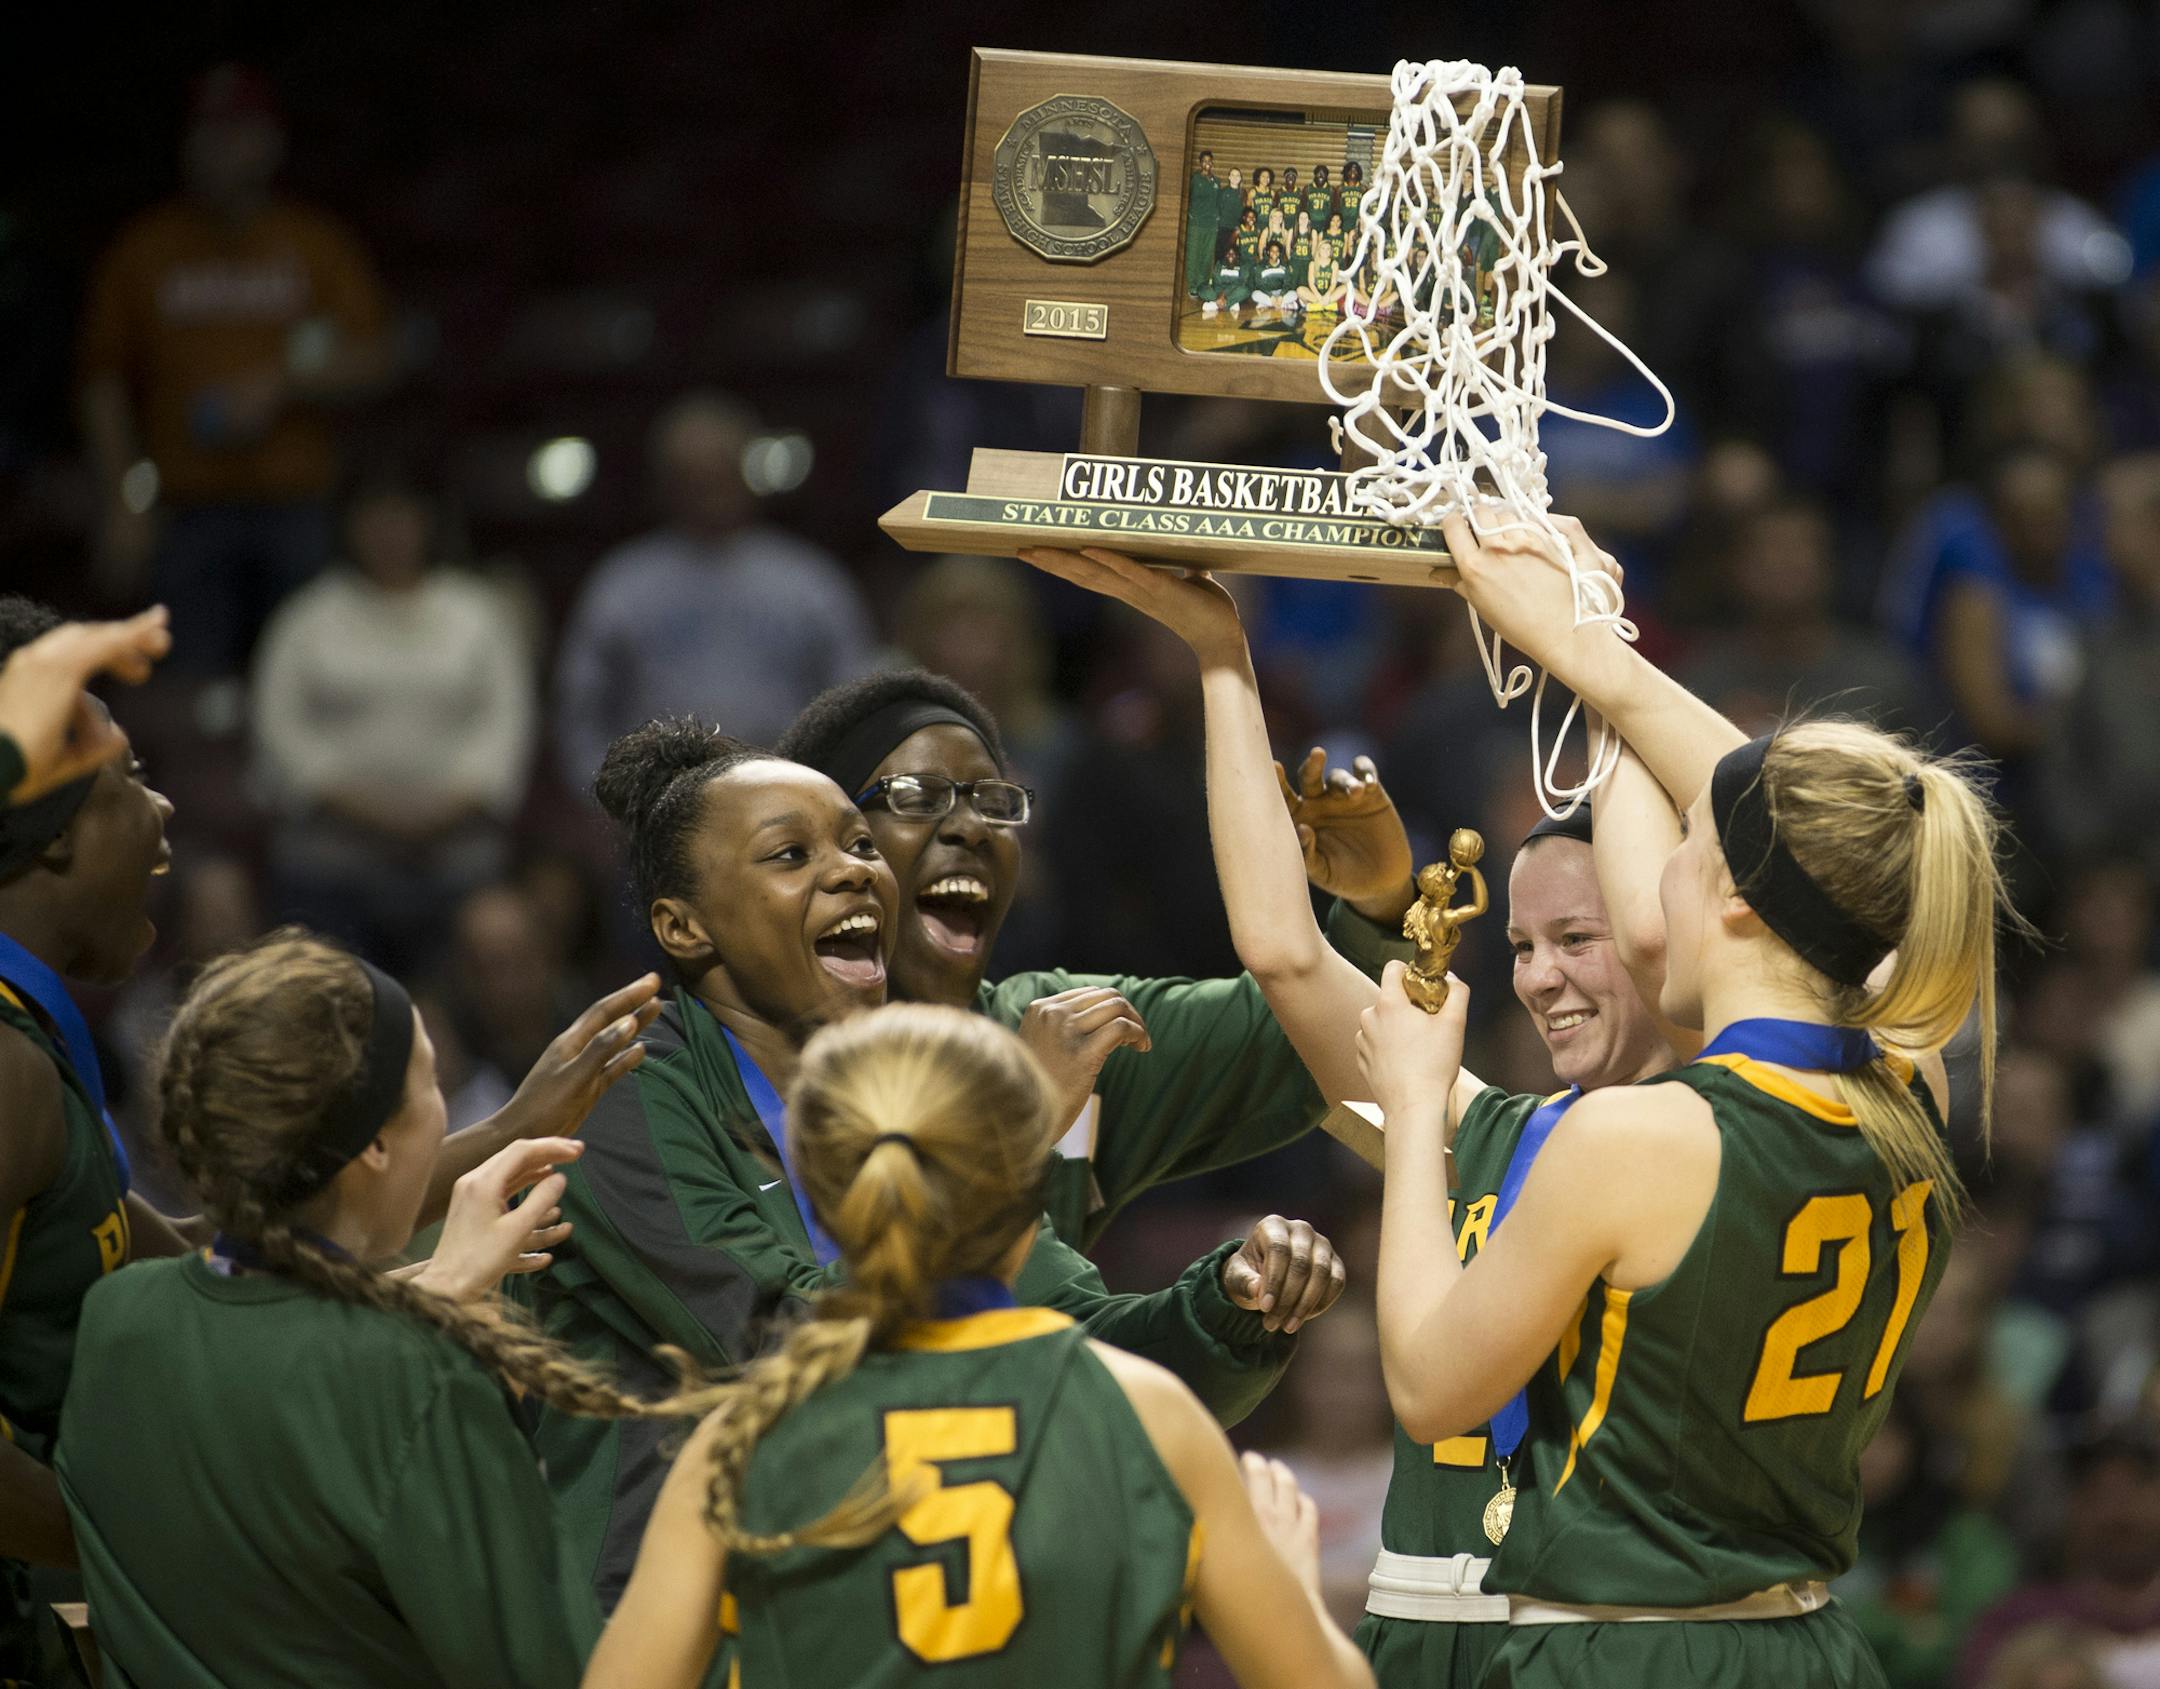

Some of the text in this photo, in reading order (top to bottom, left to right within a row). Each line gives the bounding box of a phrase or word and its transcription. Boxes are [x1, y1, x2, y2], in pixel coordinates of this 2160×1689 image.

[1022, 100, 1133, 136] MINNESOTA
[1029, 155, 1121, 195] MSHSL
[1010, 214, 1049, 250] HIGH
[1052, 233, 1121, 256] SCHOOL
[1031, 306, 1100, 332] 2015
[1065, 460, 1374, 517] GIRLS BASKETBAL
[1002, 503, 1424, 548] STATE CLASS AAA CHAMPION
[1743, 1178, 1935, 1423] 21
[884, 1406, 1024, 1664] 5
